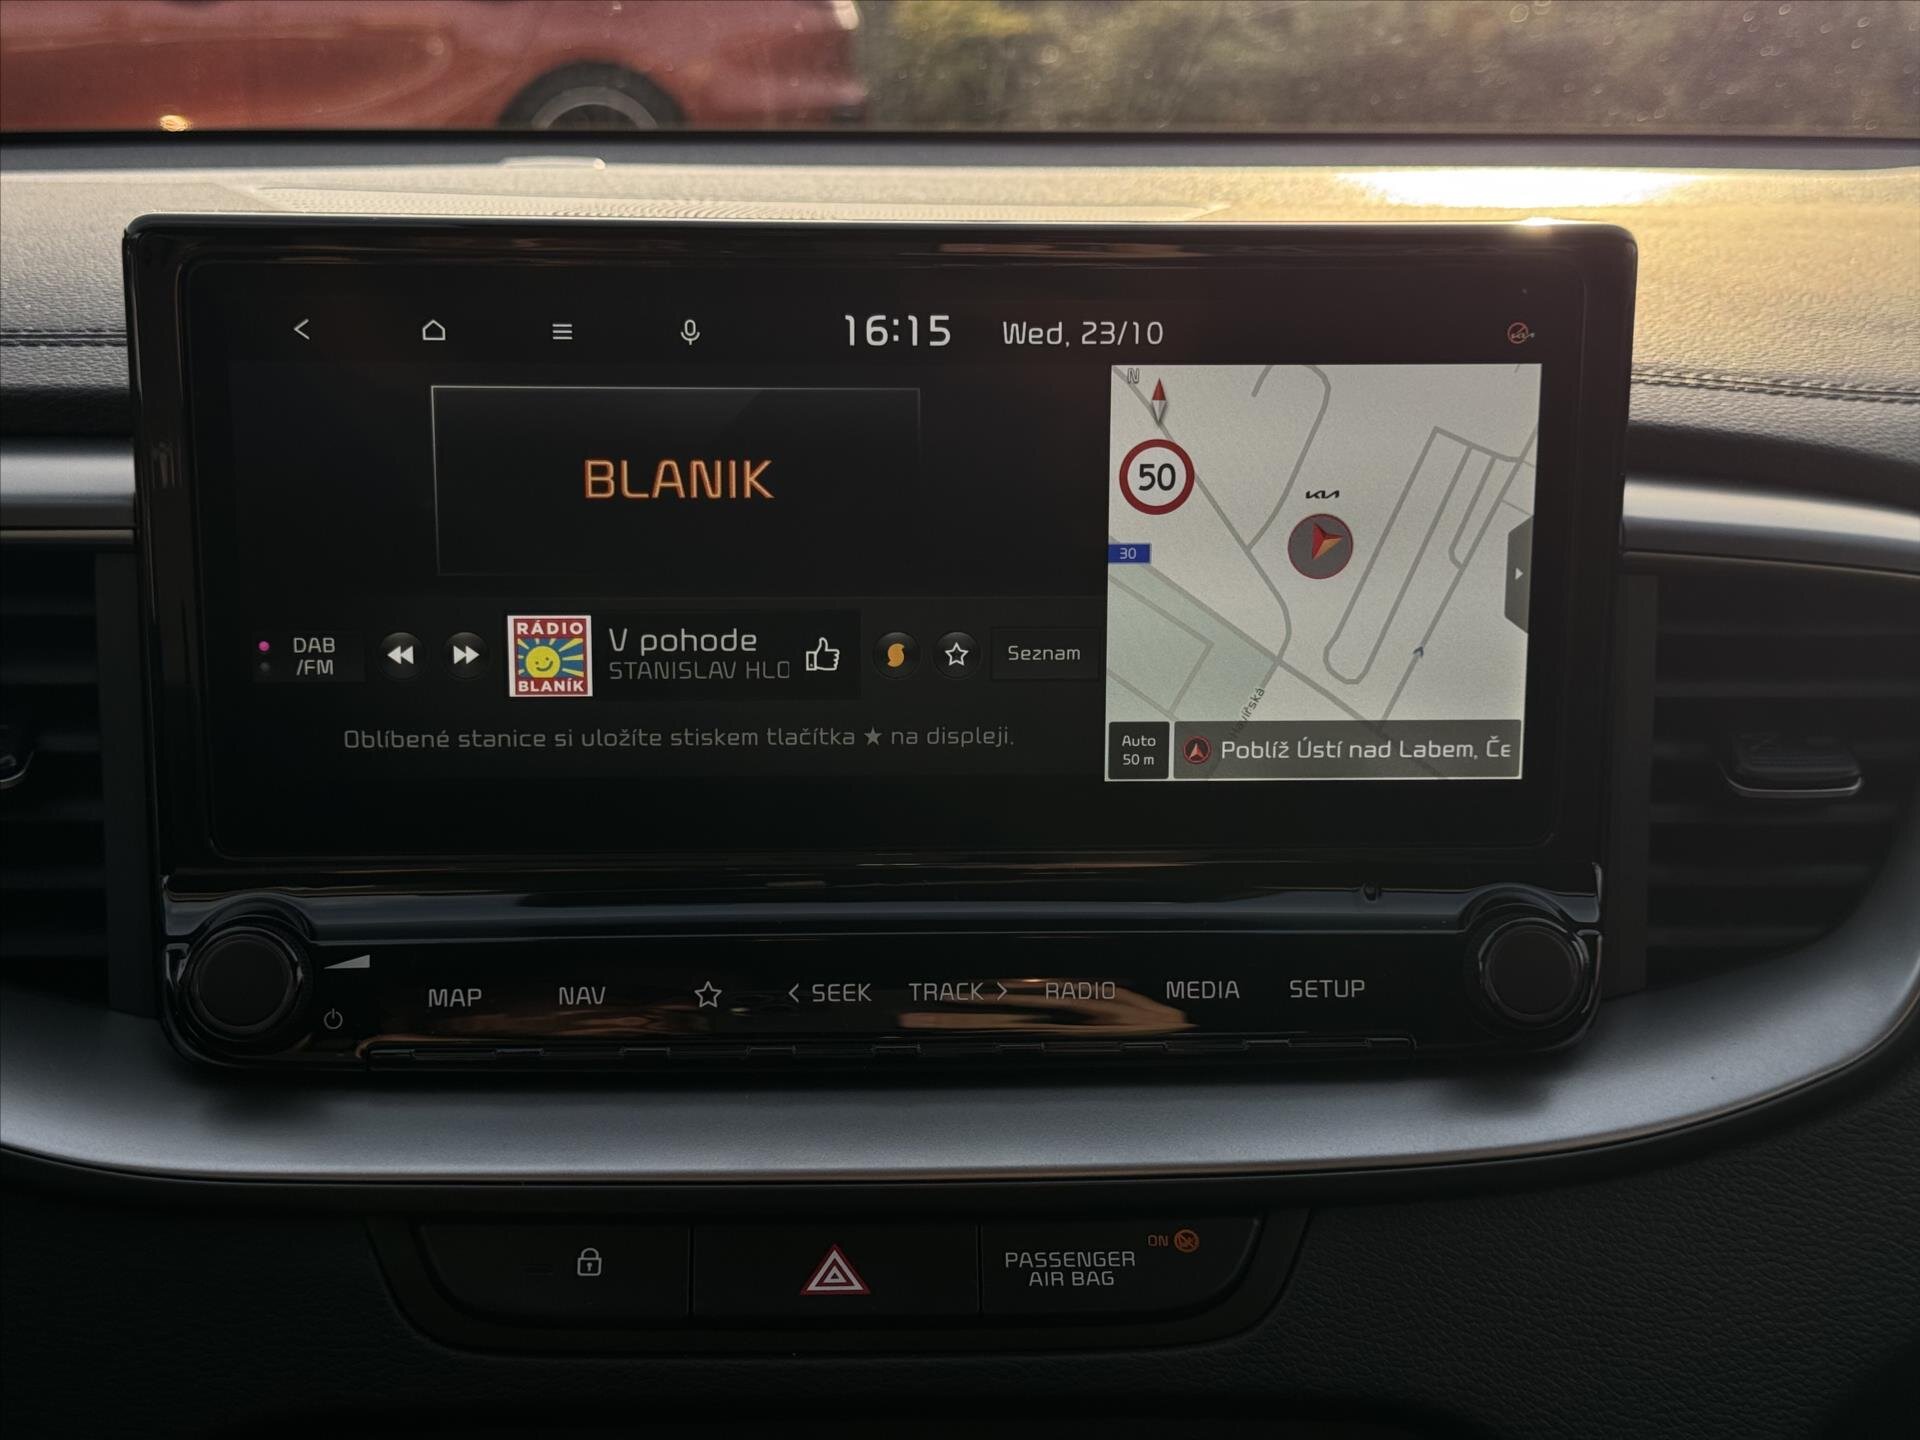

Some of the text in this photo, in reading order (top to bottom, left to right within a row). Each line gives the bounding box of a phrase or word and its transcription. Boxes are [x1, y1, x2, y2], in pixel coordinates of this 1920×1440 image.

[843, 314, 951, 347] 16:15
[1002, 320, 1164, 348] Wed, 23/10
[1127, 367, 1140, 384] N
[584, 459, 775, 500] BLANIK
[1138, 463, 1176, 491] 50
[1119, 547, 1137, 560] 30
[516, 620, 584, 635] RÁDIO
[293, 637, 336, 654] DAB
[608, 627, 757, 656] V pohode
[1007, 645, 1081, 661] Seznam
[296, 659, 334, 676] /FM
[609, 660, 790, 680] STANISLAV HLO
[518, 677, 585, 692] BLANÍK
[344, 725, 1014, 749] Oblíbené stanice si uložíte stiskem tlačítka na displeji.
[1121, 734, 1156, 747] Auto
[1221, 740, 1290, 759] Poblíž
[1297, 736, 1343, 759] Ústí
[1349, 740, 1392, 758] nad
[1399, 740, 1478, 760] Labem,
[1123, 753, 1155, 766] 50 m
[428, 988, 482, 1008] MAP
[559, 986, 606, 1006] NAV
[811, 983, 873, 1003] SEEK
[908, 982, 984, 1001] TRACK
[1045, 981, 1116, 1000] RADIO
[1166, 980, 1240, 999] MEDIA
[1289, 979, 1365, 998] SETUP
[1147, 1234, 1169, 1247] ON
[1005, 1250, 1136, 1268] PASSENGER
[1028, 1270, 1115, 1287] AIR BAG
